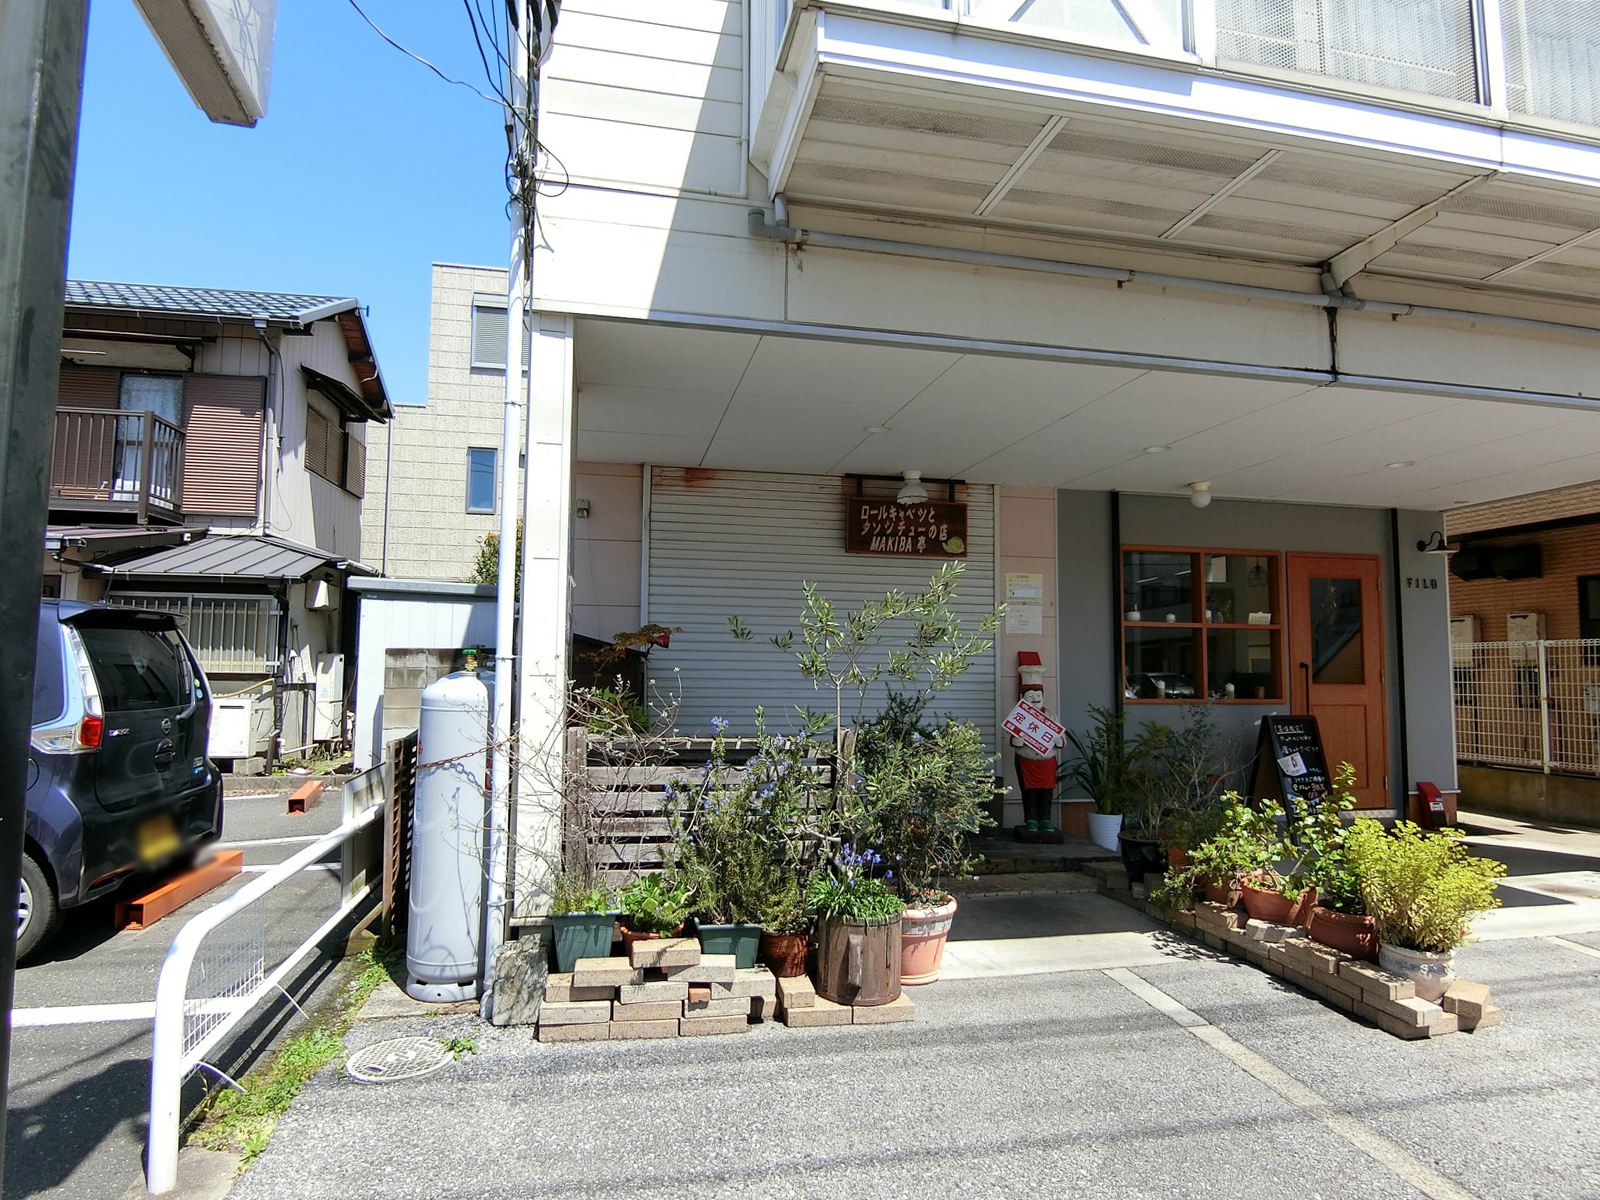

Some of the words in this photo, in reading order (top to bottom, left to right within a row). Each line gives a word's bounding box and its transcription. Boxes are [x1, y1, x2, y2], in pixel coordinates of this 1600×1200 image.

[861, 505, 936, 523] ロールキャベツと
[861, 520, 949, 541] タンシチューの店
[1406, 578, 1438, 589] FILO
[1012, 712, 1053, 743] 定休日
